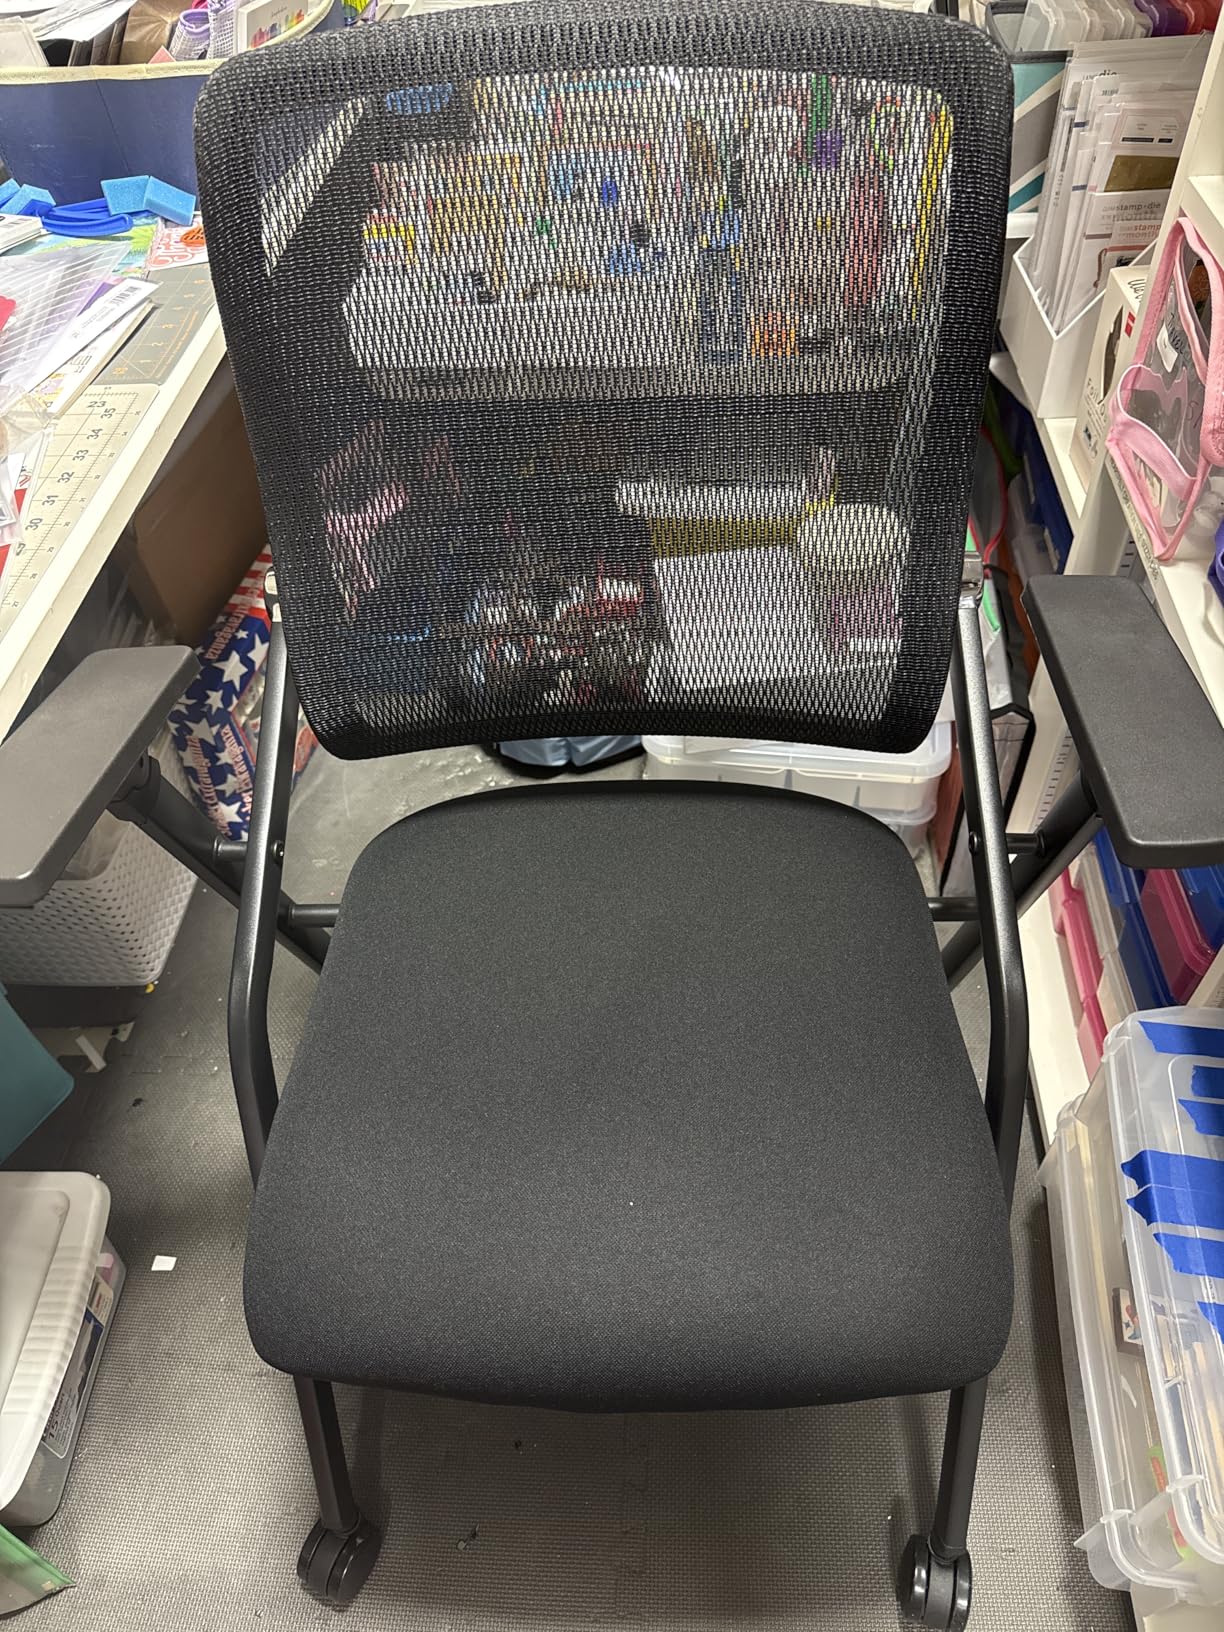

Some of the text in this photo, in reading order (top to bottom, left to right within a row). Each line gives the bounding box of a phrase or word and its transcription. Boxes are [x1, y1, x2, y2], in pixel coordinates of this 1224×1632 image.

[86, 400, 107, 408] 23
[100, 408, 116, 419] 35
[86, 428, 103, 440] 34
[72, 449, 89, 461] 33
[57, 471, 75, 483] 32
[42, 495, 58, 506] 31
[25, 517, 43, 531] 30
[48, 1420, 59, 1440] 15
